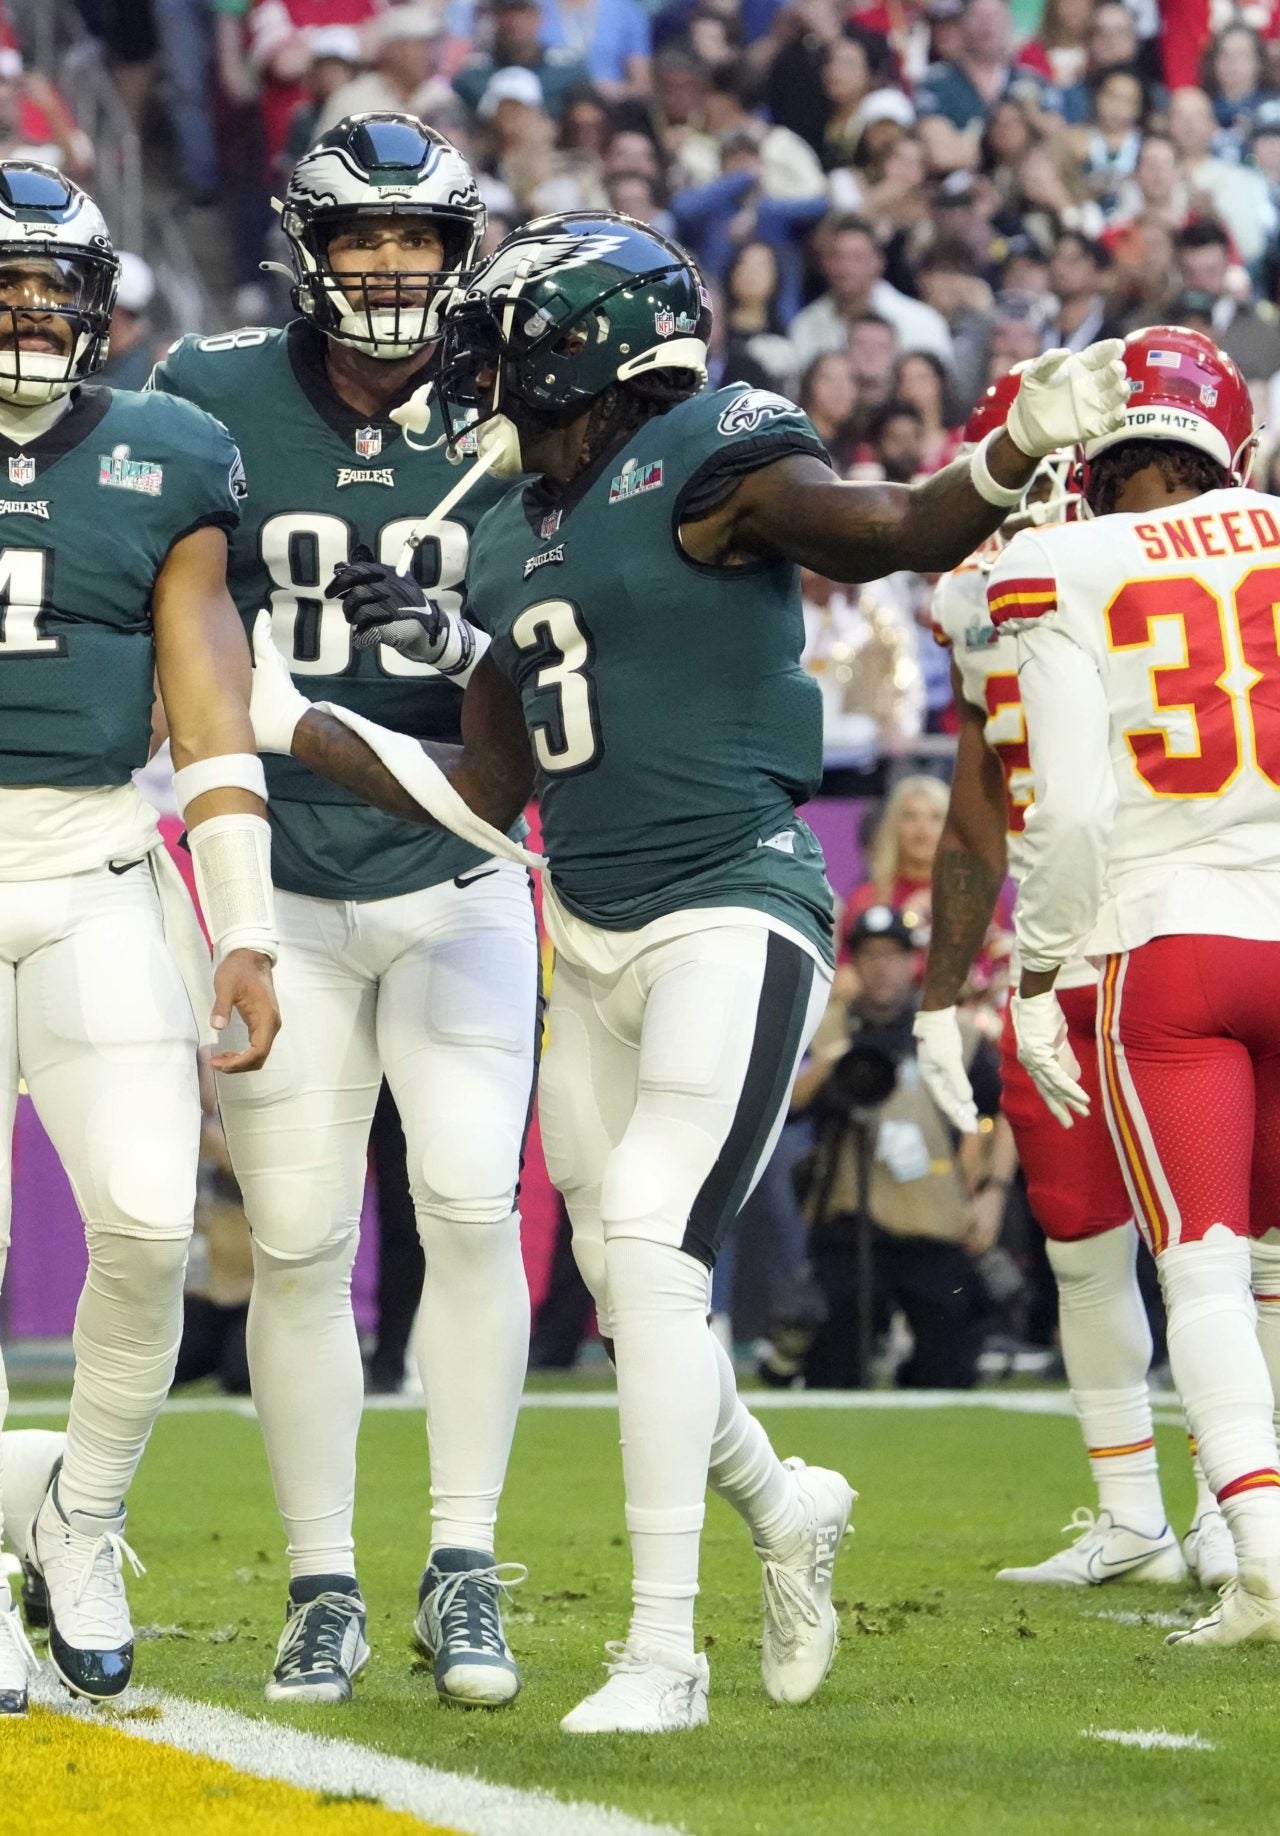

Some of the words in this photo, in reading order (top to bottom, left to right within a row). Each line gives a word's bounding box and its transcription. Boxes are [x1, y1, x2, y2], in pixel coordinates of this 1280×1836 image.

[1126, 413, 1156, 426] TOP
[336, 468, 395, 488] EAGLES
[1134, 508, 1280, 561] SNEED
[524, 543, 564, 578] EAGLES
[511, 598, 596, 772] 3
